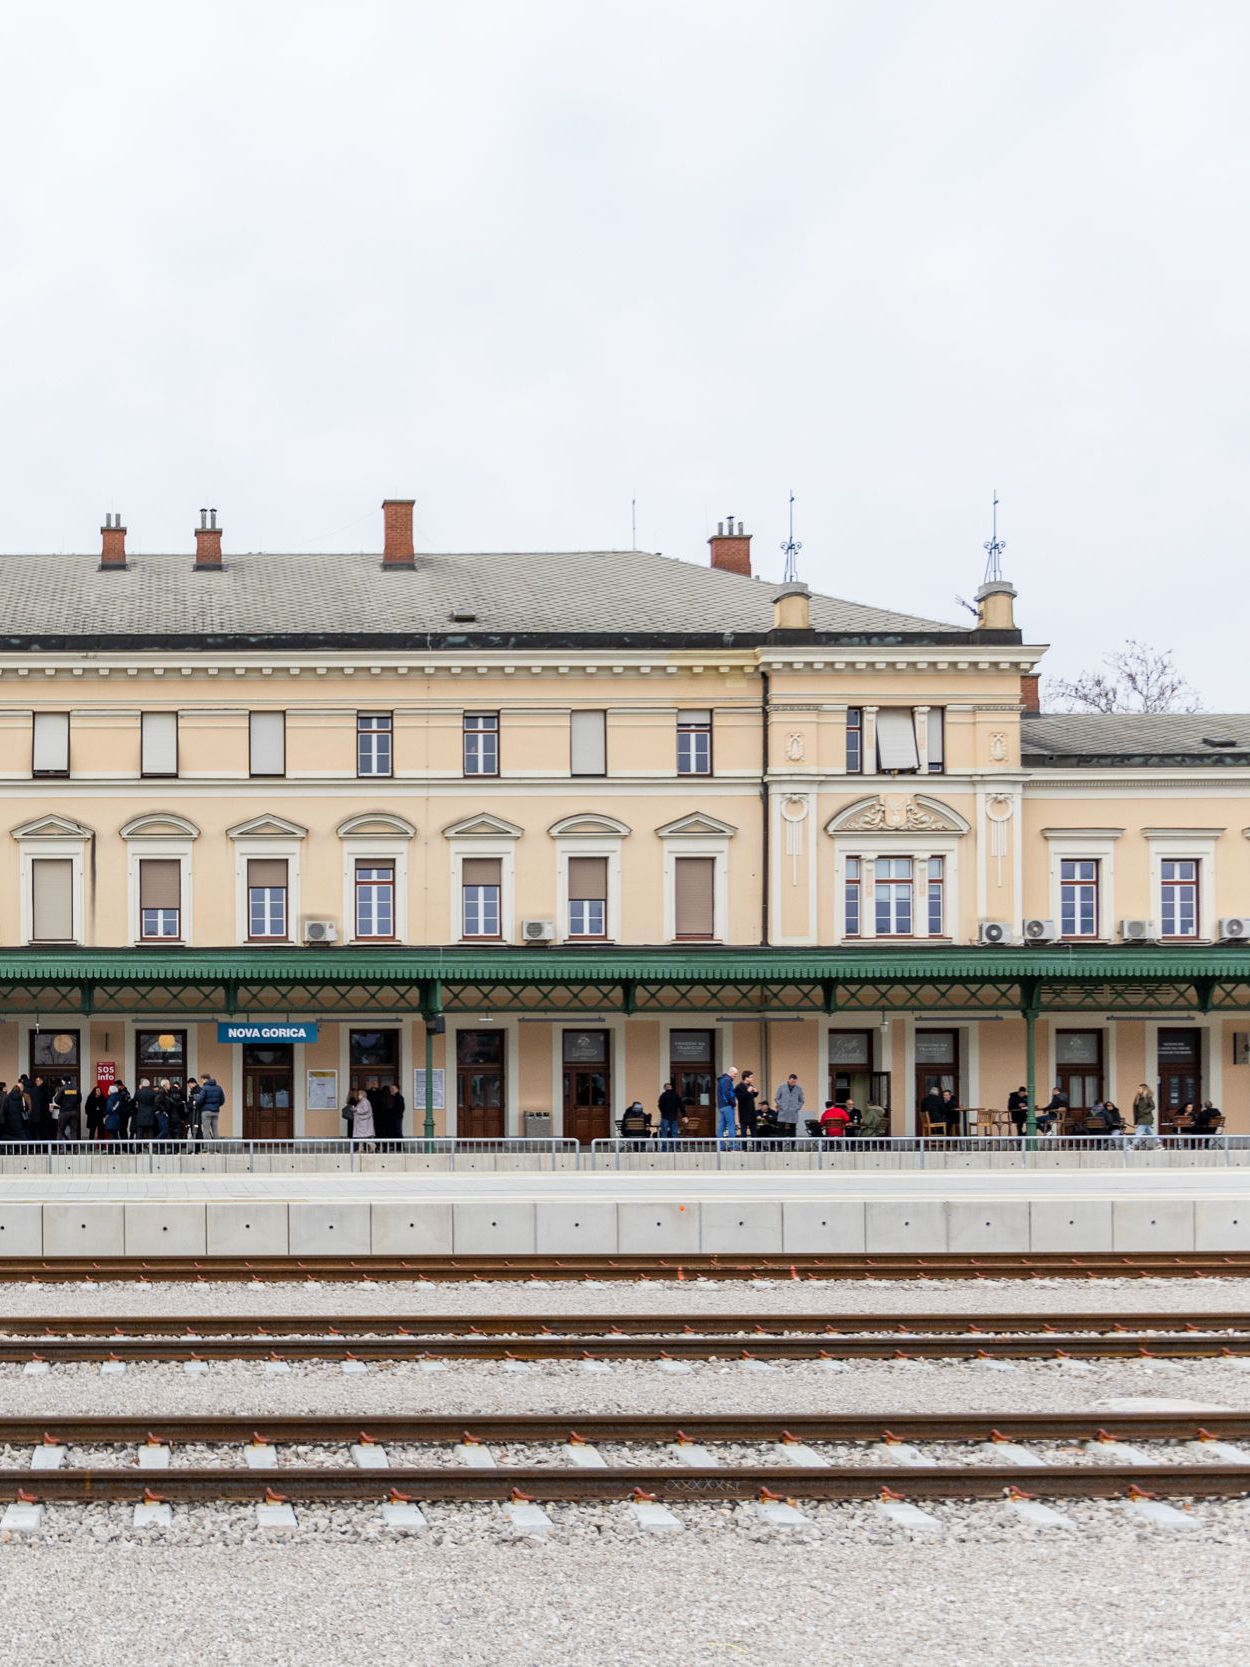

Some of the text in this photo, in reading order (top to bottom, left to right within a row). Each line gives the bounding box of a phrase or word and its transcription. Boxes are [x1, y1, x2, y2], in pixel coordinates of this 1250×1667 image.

[228, 1028, 307, 1038] NOVA GORICA
[97, 1073, 115, 1081] info
